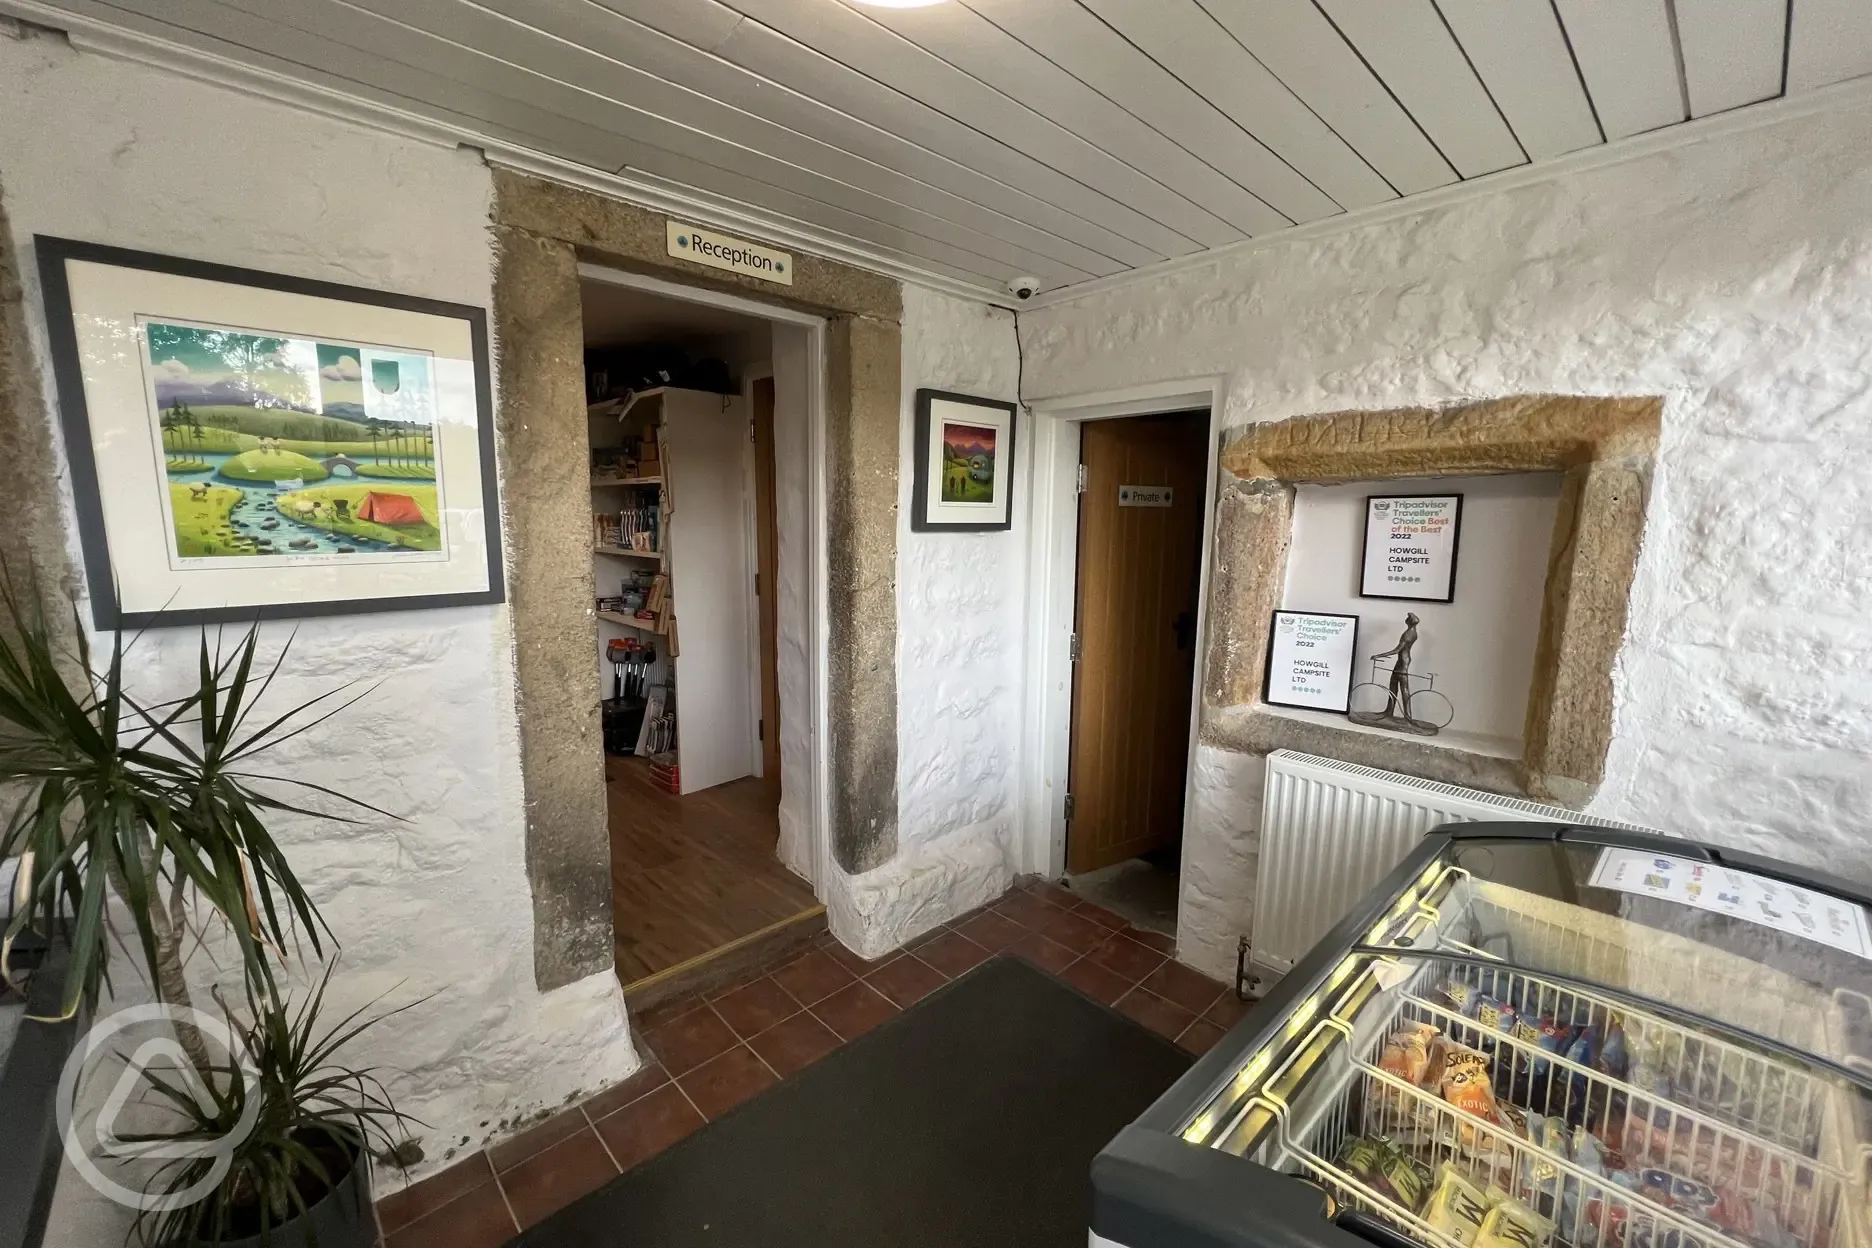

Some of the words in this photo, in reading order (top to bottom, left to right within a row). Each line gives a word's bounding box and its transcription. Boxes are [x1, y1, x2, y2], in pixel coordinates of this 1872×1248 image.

[692, 233, 772, 271] Reception
[1132, 490, 1160, 502] Private
[1393, 501, 1448, 509] Tripadvisor
[1393, 509, 1443, 517] Travellers'
[1392, 517, 1426, 525] Choice
[1427, 517, 1449, 525] Best
[1391, 525, 1400, 533] of
[1403, 525, 1419, 533] the
[1420, 525, 1442, 533] Best
[1389, 547, 1429, 555] HOWGILL
[1388, 556, 1430, 564] CAMPSITE
[1298, 618, 1347, 628] Tripadvisor
[1296, 632, 1327, 641] Choice
[1293, 659, 1329, 668] HOWGILL
[1293, 668, 1330, 677] CAMPSITE
